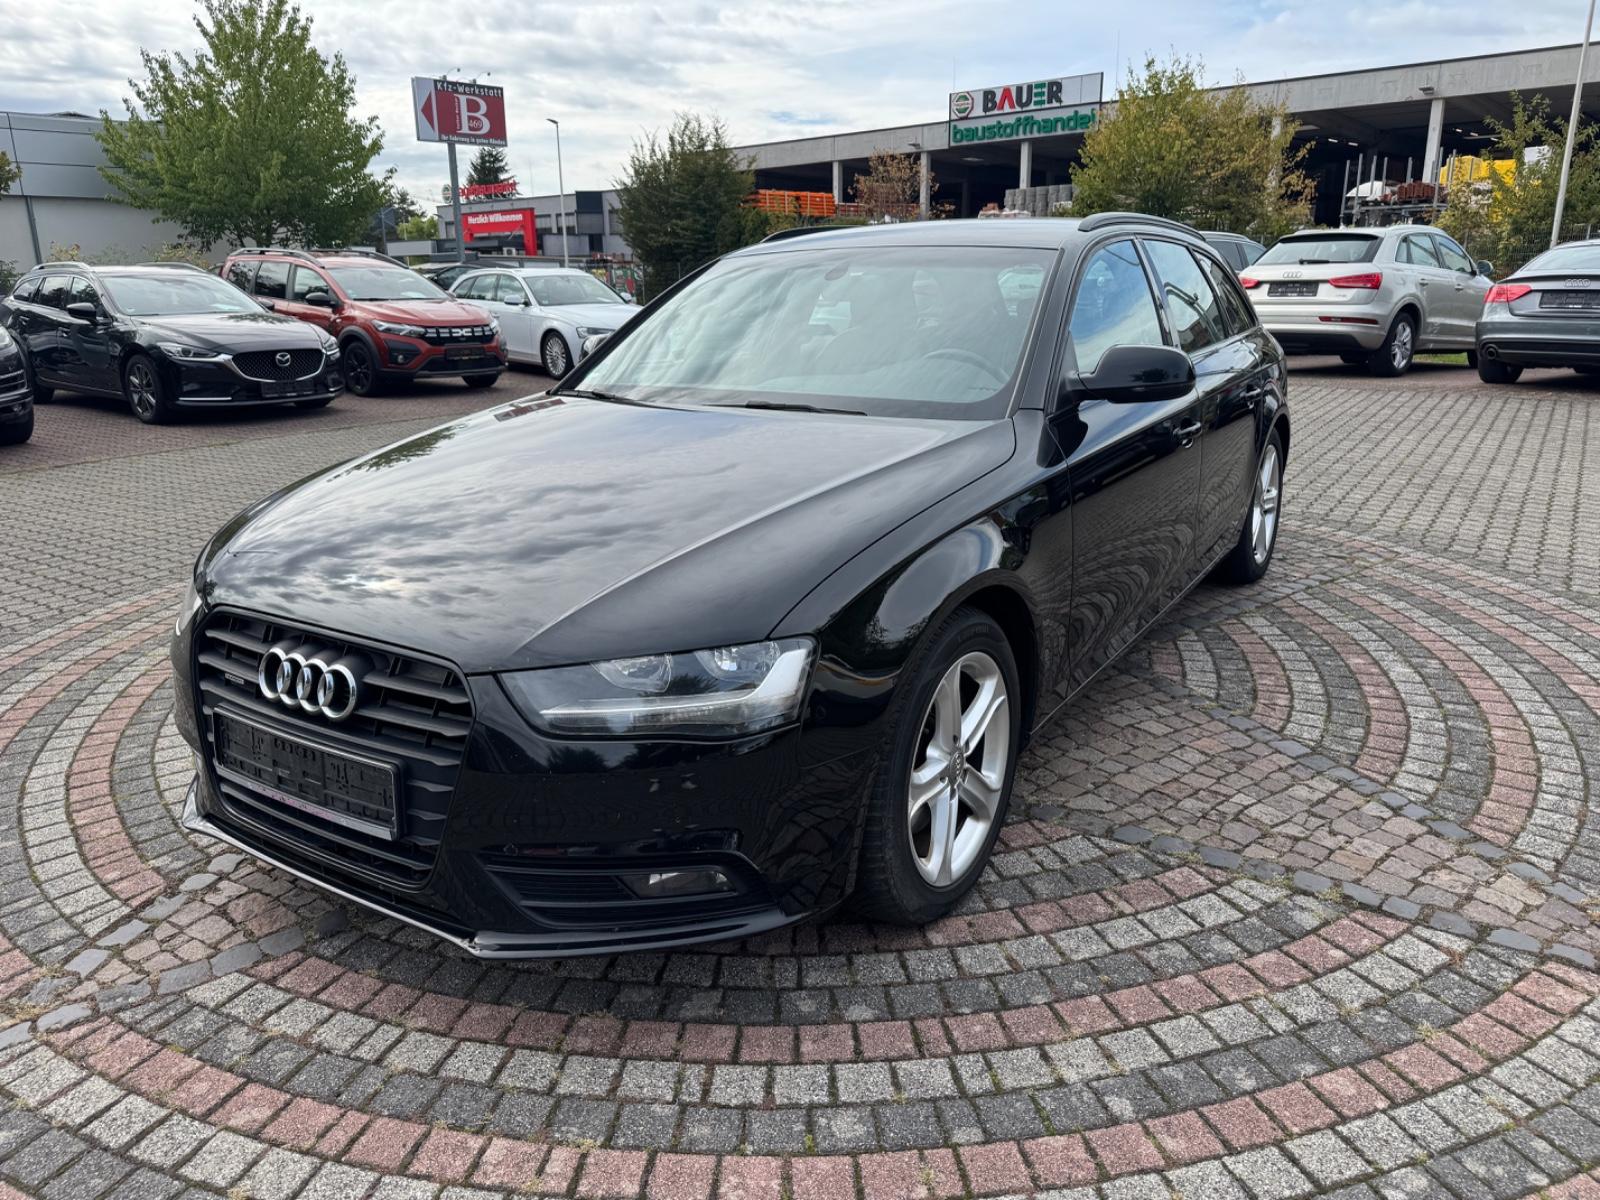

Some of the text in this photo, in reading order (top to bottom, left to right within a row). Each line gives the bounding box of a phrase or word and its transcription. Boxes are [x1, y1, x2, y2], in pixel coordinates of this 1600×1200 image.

[436, 82, 502, 97] Kfz-Werkstatt
[983, 82, 1063, 113] BAUER
[454, 93, 491, 135] B
[952, 108, 1096, 143] baustoffhandel
